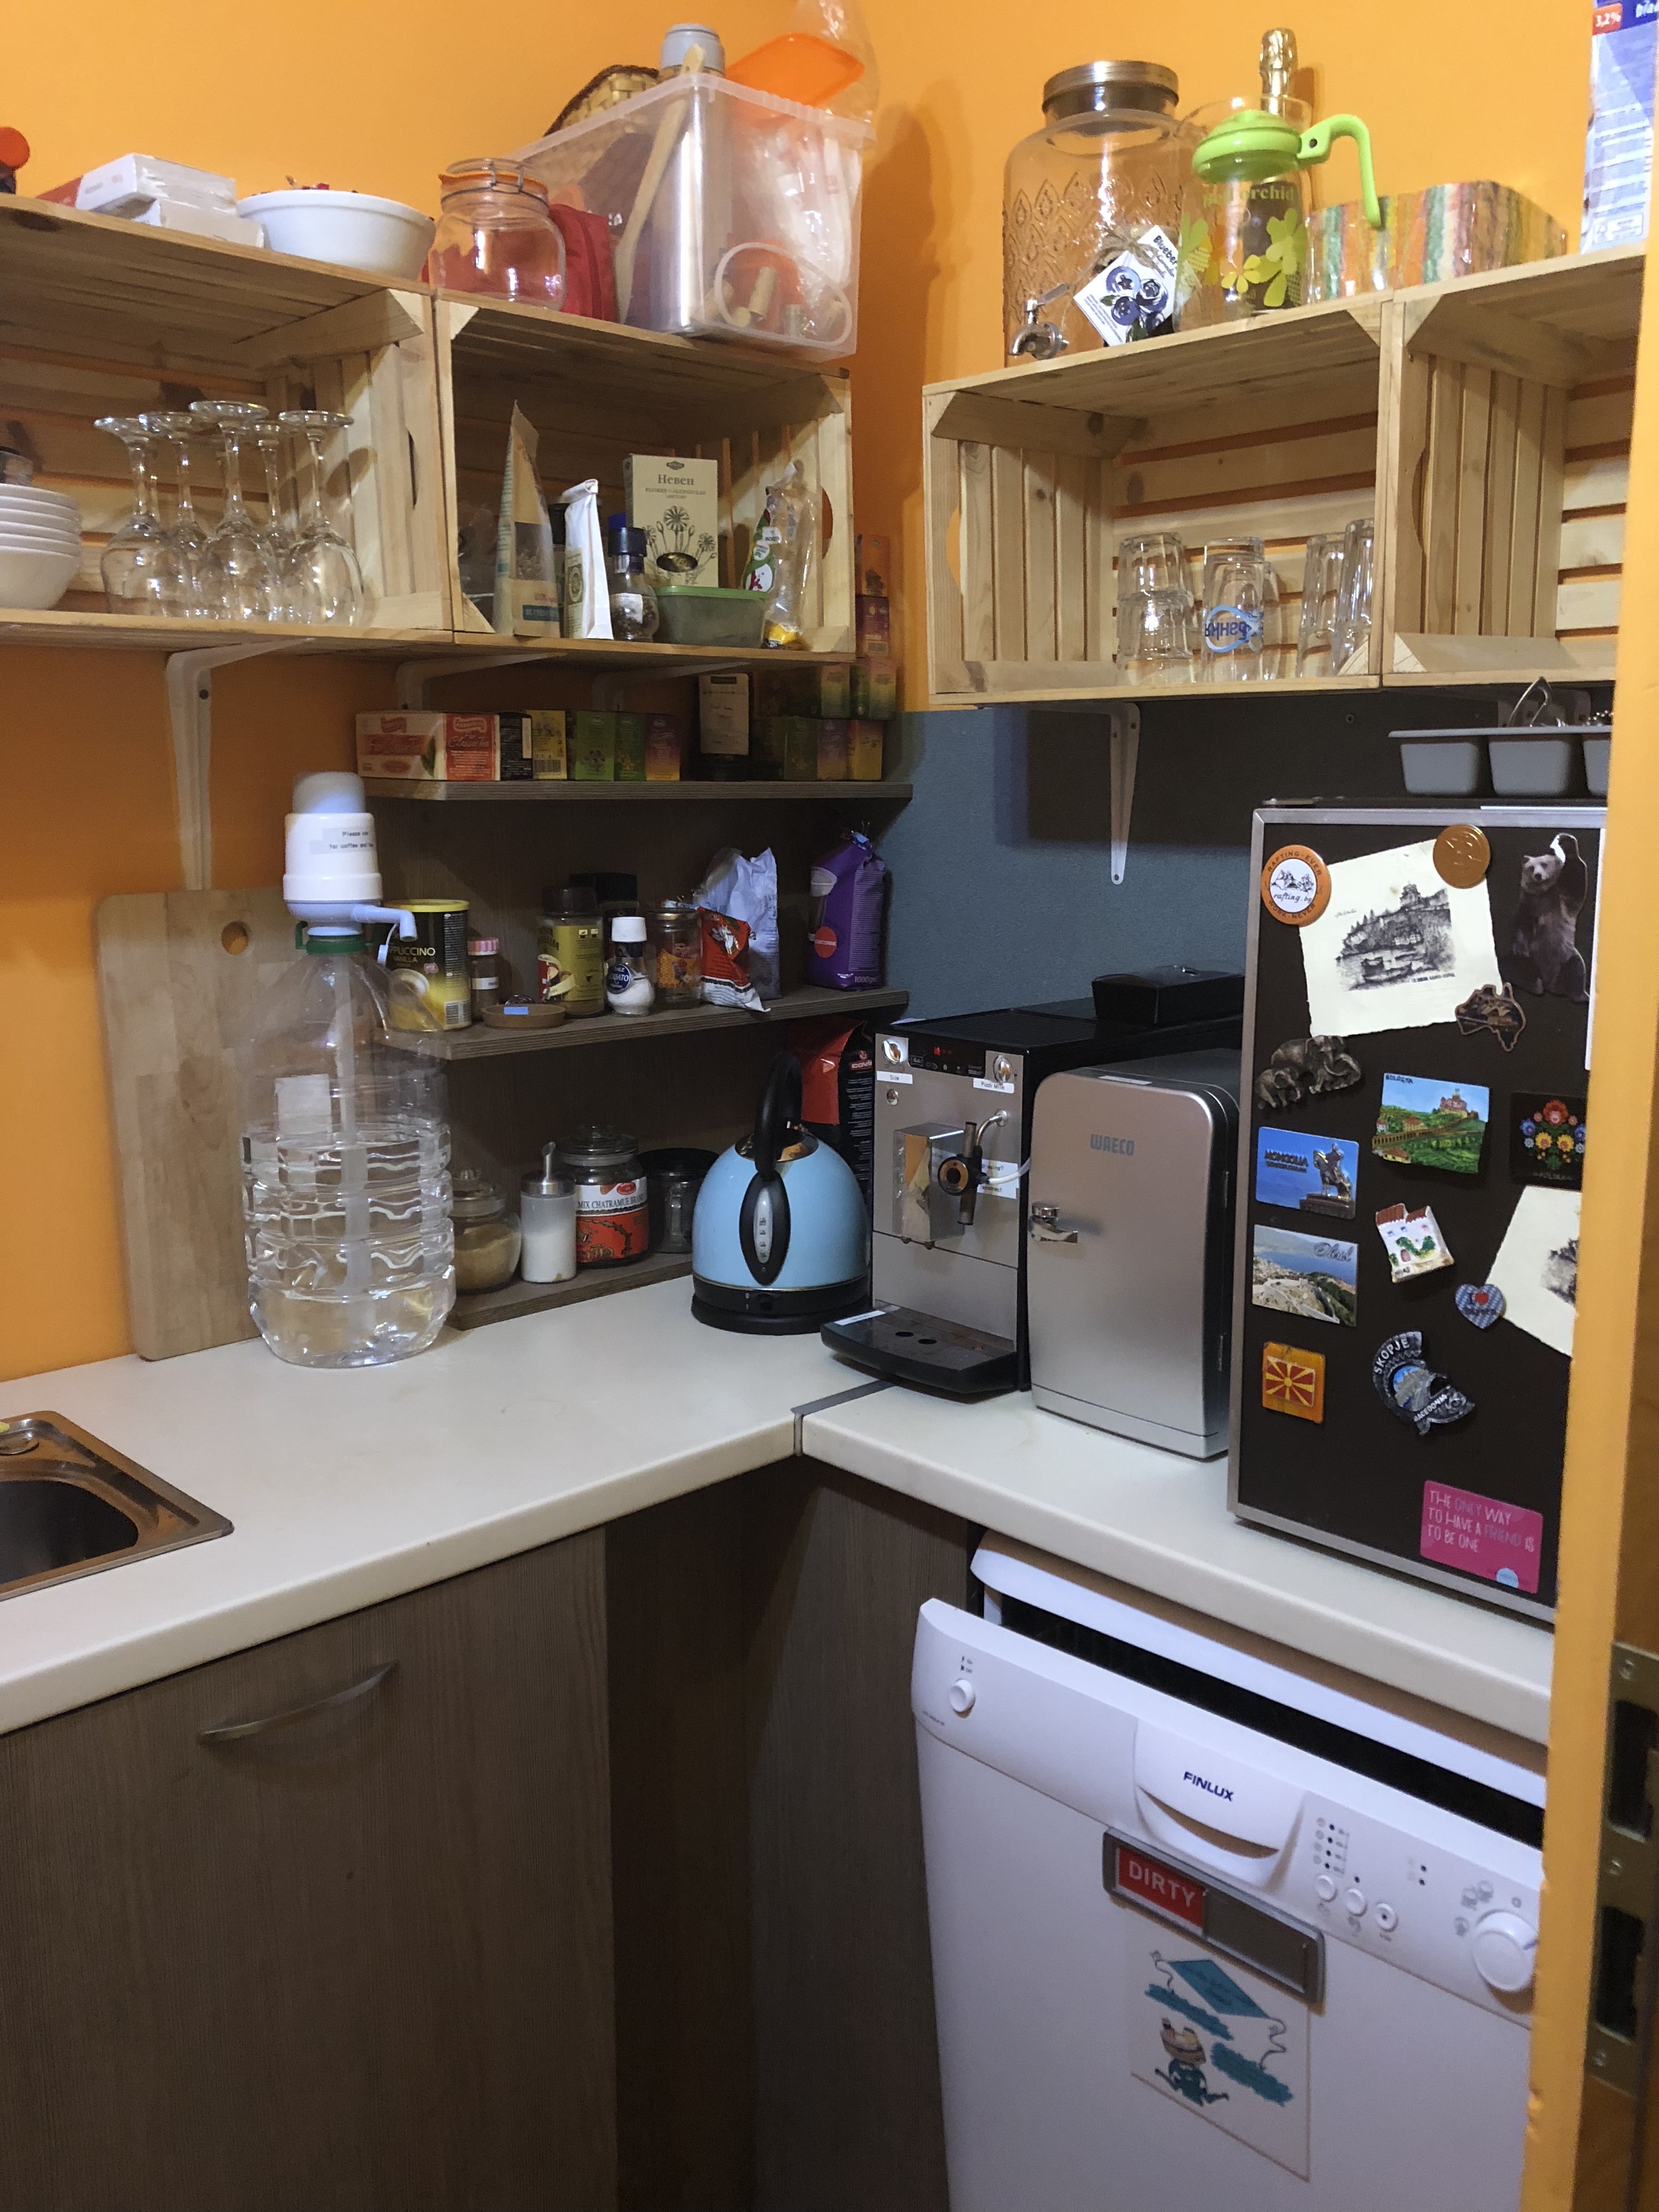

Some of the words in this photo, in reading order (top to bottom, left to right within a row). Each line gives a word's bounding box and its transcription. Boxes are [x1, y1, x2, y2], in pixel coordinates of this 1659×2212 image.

[1153, 235, 1178, 268] Blueber
[658, 474, 694, 486] Невен
[1267, 851, 1300, 872] RAFTING
[1305, 855, 1322, 876] EVER
[1268, 900, 1286, 918] WORK
[1292, 903, 1316, 919] NEVER
[1273, 892, 1312, 904] rafting.bg
[1090, 1133, 1135, 1156] WAECO
[1264, 1149, 1308, 1167] MONGOLIA
[591, 1197, 630, 1209] CHATRAMUE
[1373, 1338, 1410, 1375] SKOPJE
[1430, 1490, 1451, 1509] THE
[1454, 1498, 1481, 1516] ONLY
[1484, 1506, 1511, 1525] WAY
[1427, 1525, 1441, 1541] TO
[1444, 1530, 1455, 1545] BE
[1458, 1534, 1479, 1553] ONE
[1429, 1507, 1443, 1523] TO
[1446, 1511, 1473, 1533] HAVE
[1475, 1522, 1481, 1536] A
[1484, 1525, 1521, 1547] FRIEND
[1524, 1537, 1534, 1553] IS
[1183, 1771, 1234, 1802] FINLUX
[1128, 1860, 1195, 1908] DIRTY
